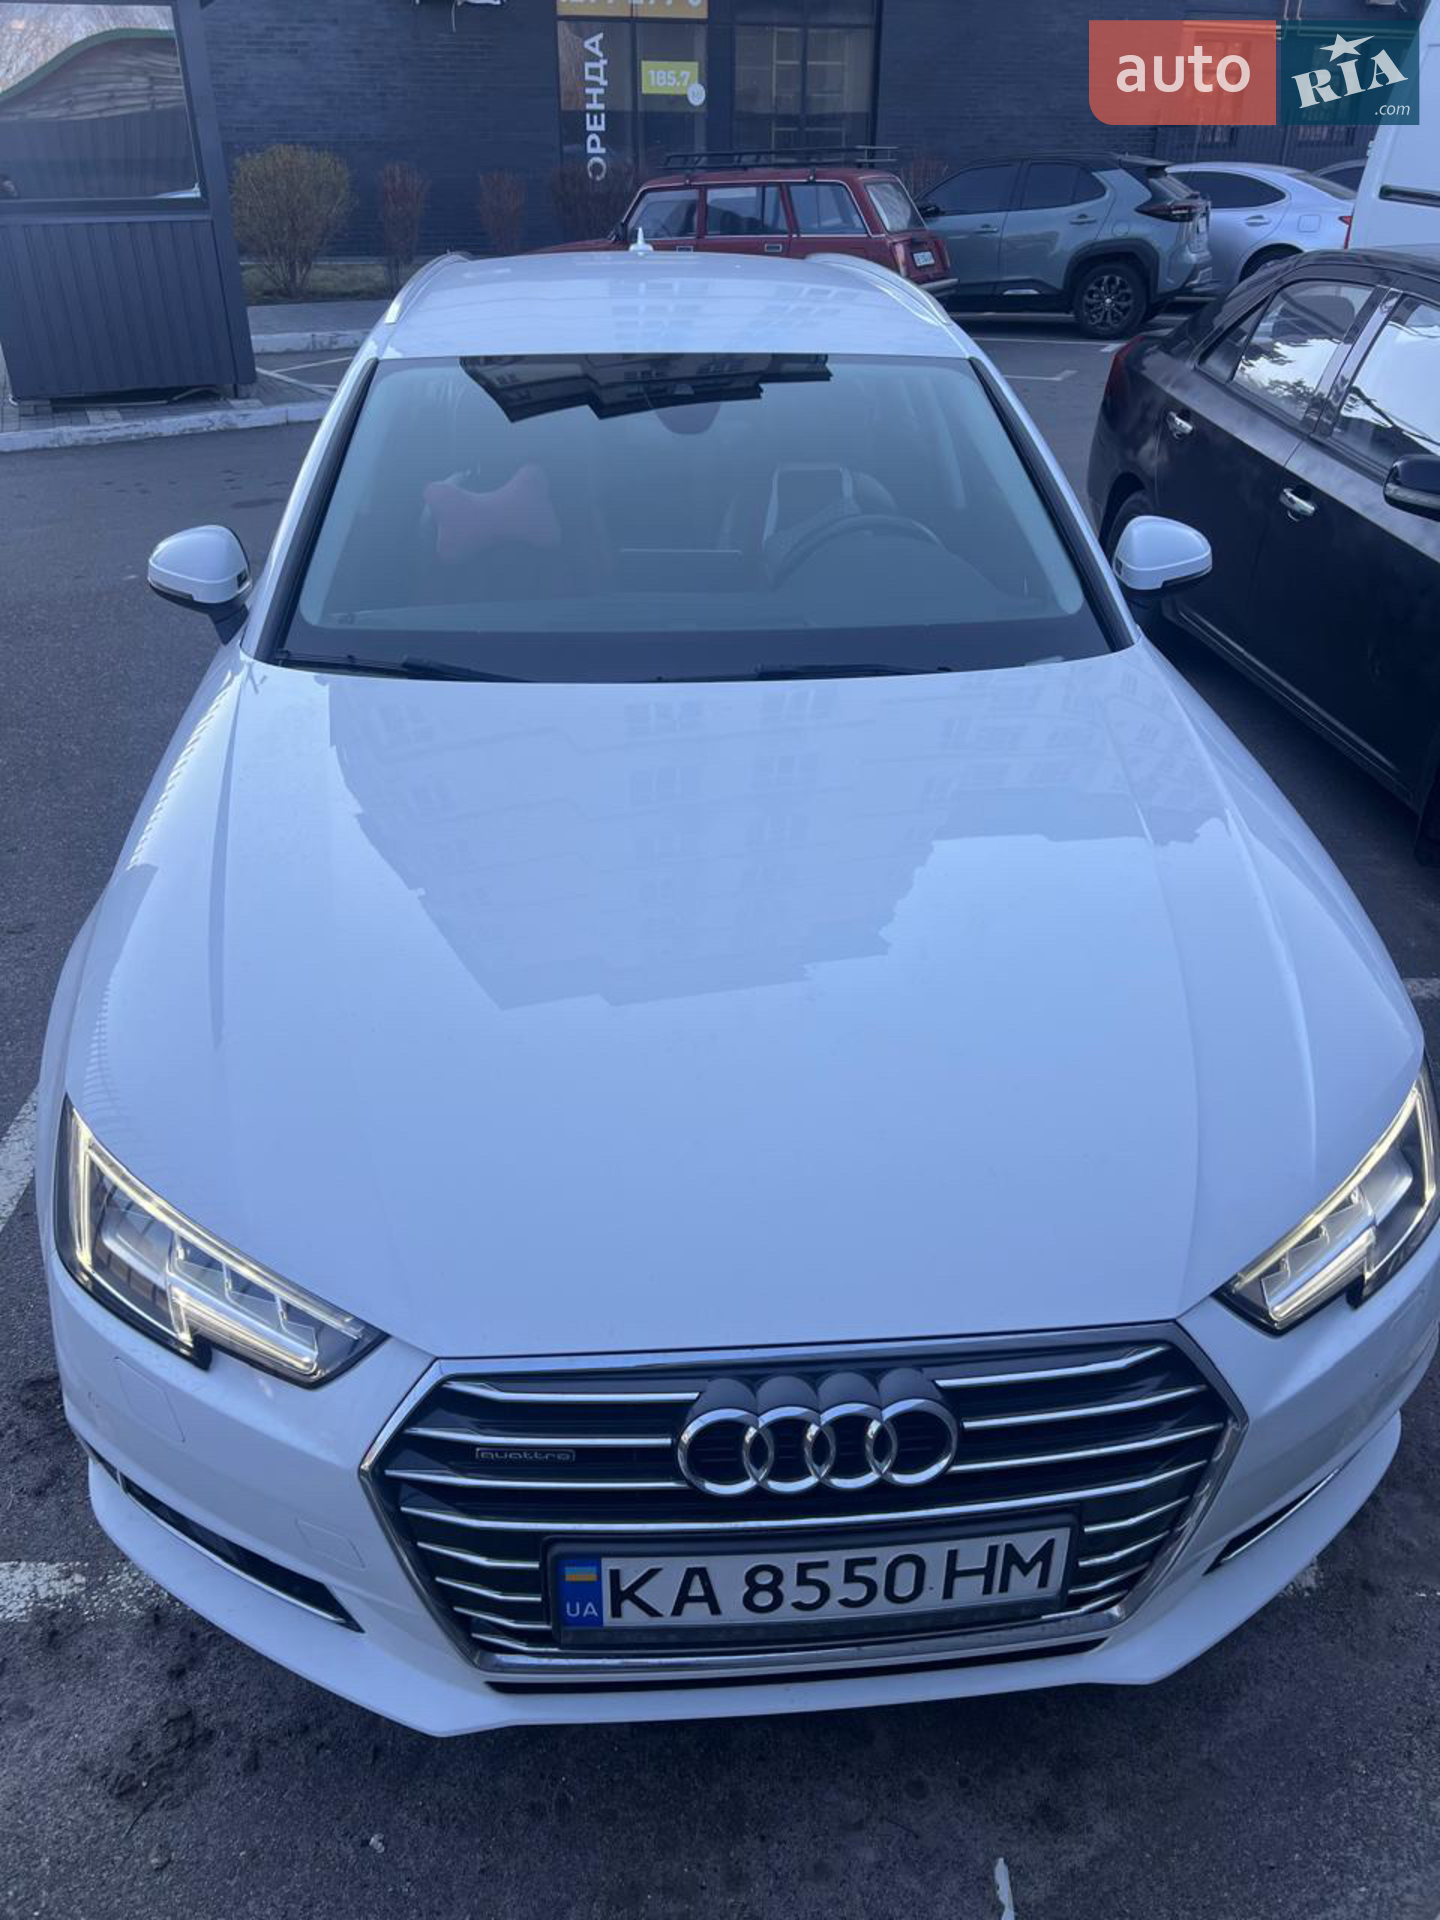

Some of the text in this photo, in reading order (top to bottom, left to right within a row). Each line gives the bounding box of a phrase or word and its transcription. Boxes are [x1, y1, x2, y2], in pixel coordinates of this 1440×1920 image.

[480, 1450, 571, 1461] quattro
[608, 1538, 1056, 1618] KA 8550 HM
[565, 1602, 598, 1618] UA
